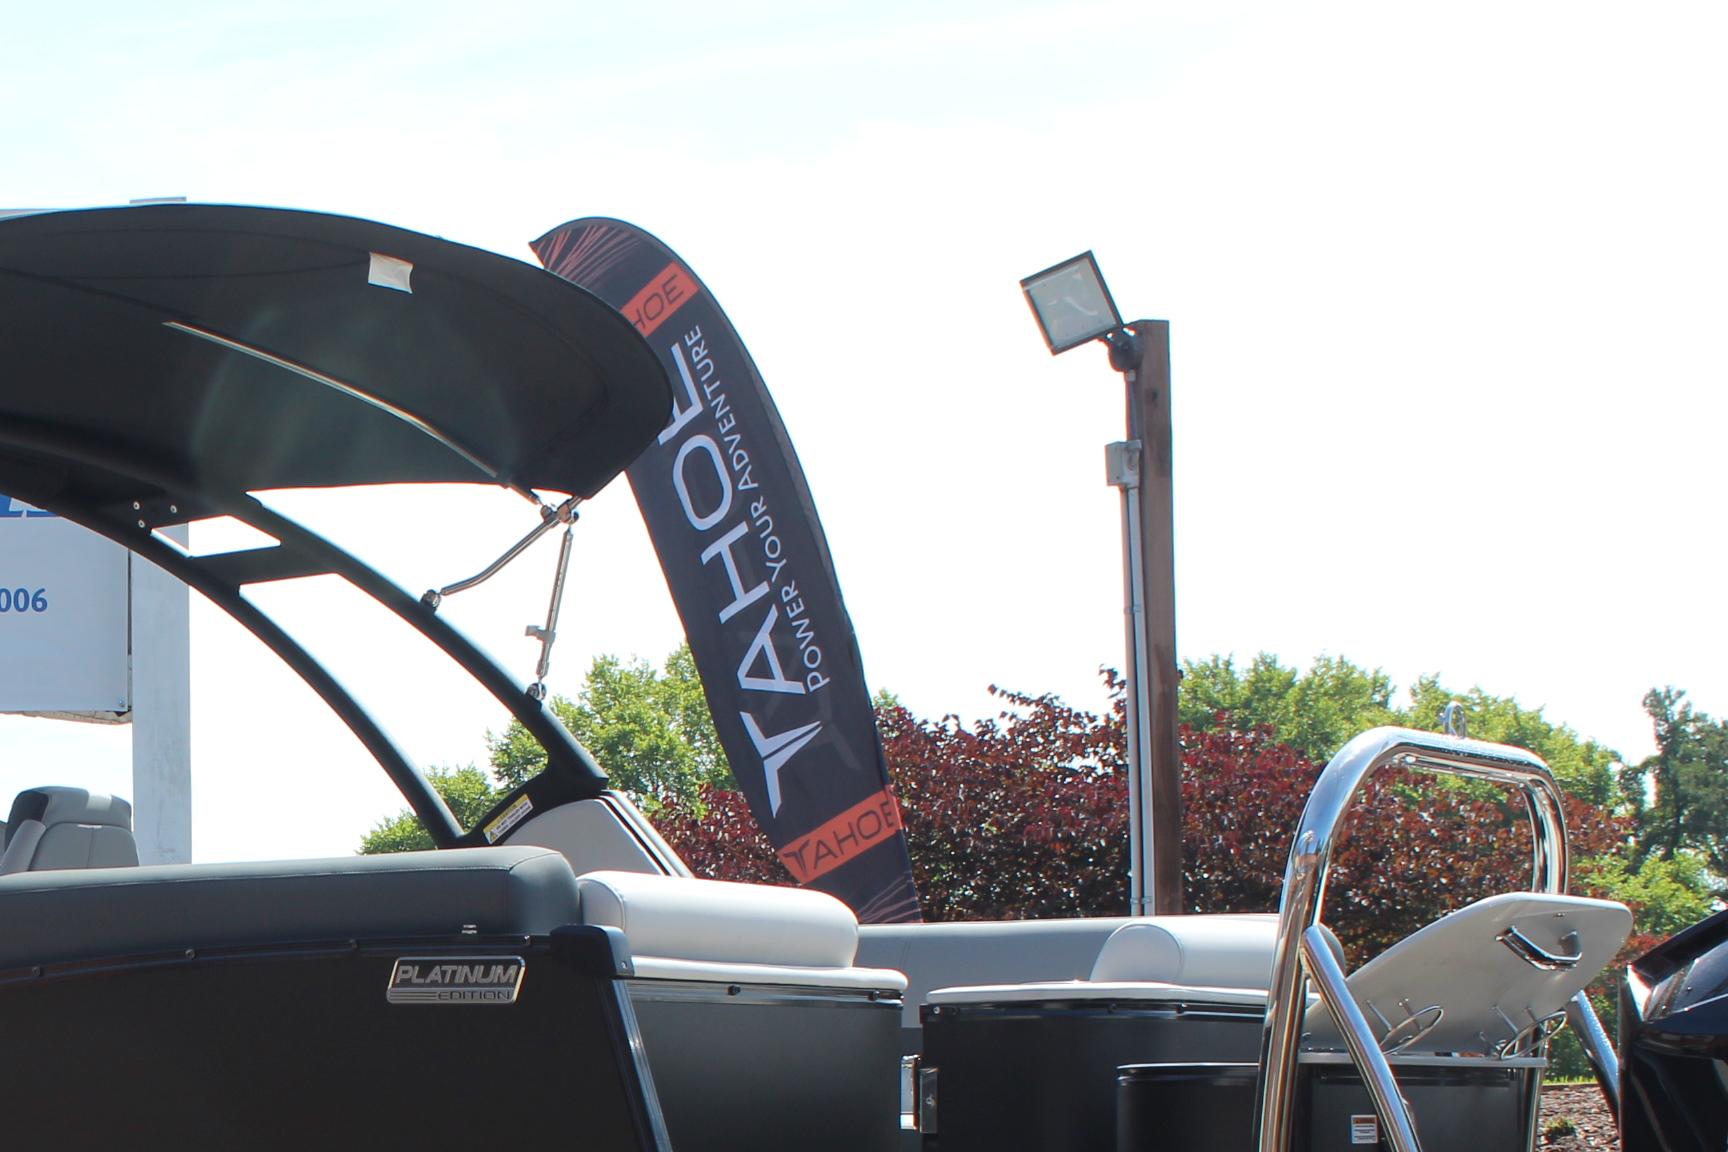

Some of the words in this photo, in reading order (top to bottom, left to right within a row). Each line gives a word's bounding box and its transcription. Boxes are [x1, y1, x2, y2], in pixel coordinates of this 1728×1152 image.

[633, 274, 684, 329] HOE
[684, 325, 759, 491] ADVENTURE
[750, 495, 787, 583] YOUR
[781, 580, 830, 691] POWER
[783, 800, 895, 876] TAHOE
[395, 964, 519, 984] PLATINUM
[436, 990, 511, 1001] EDITION
